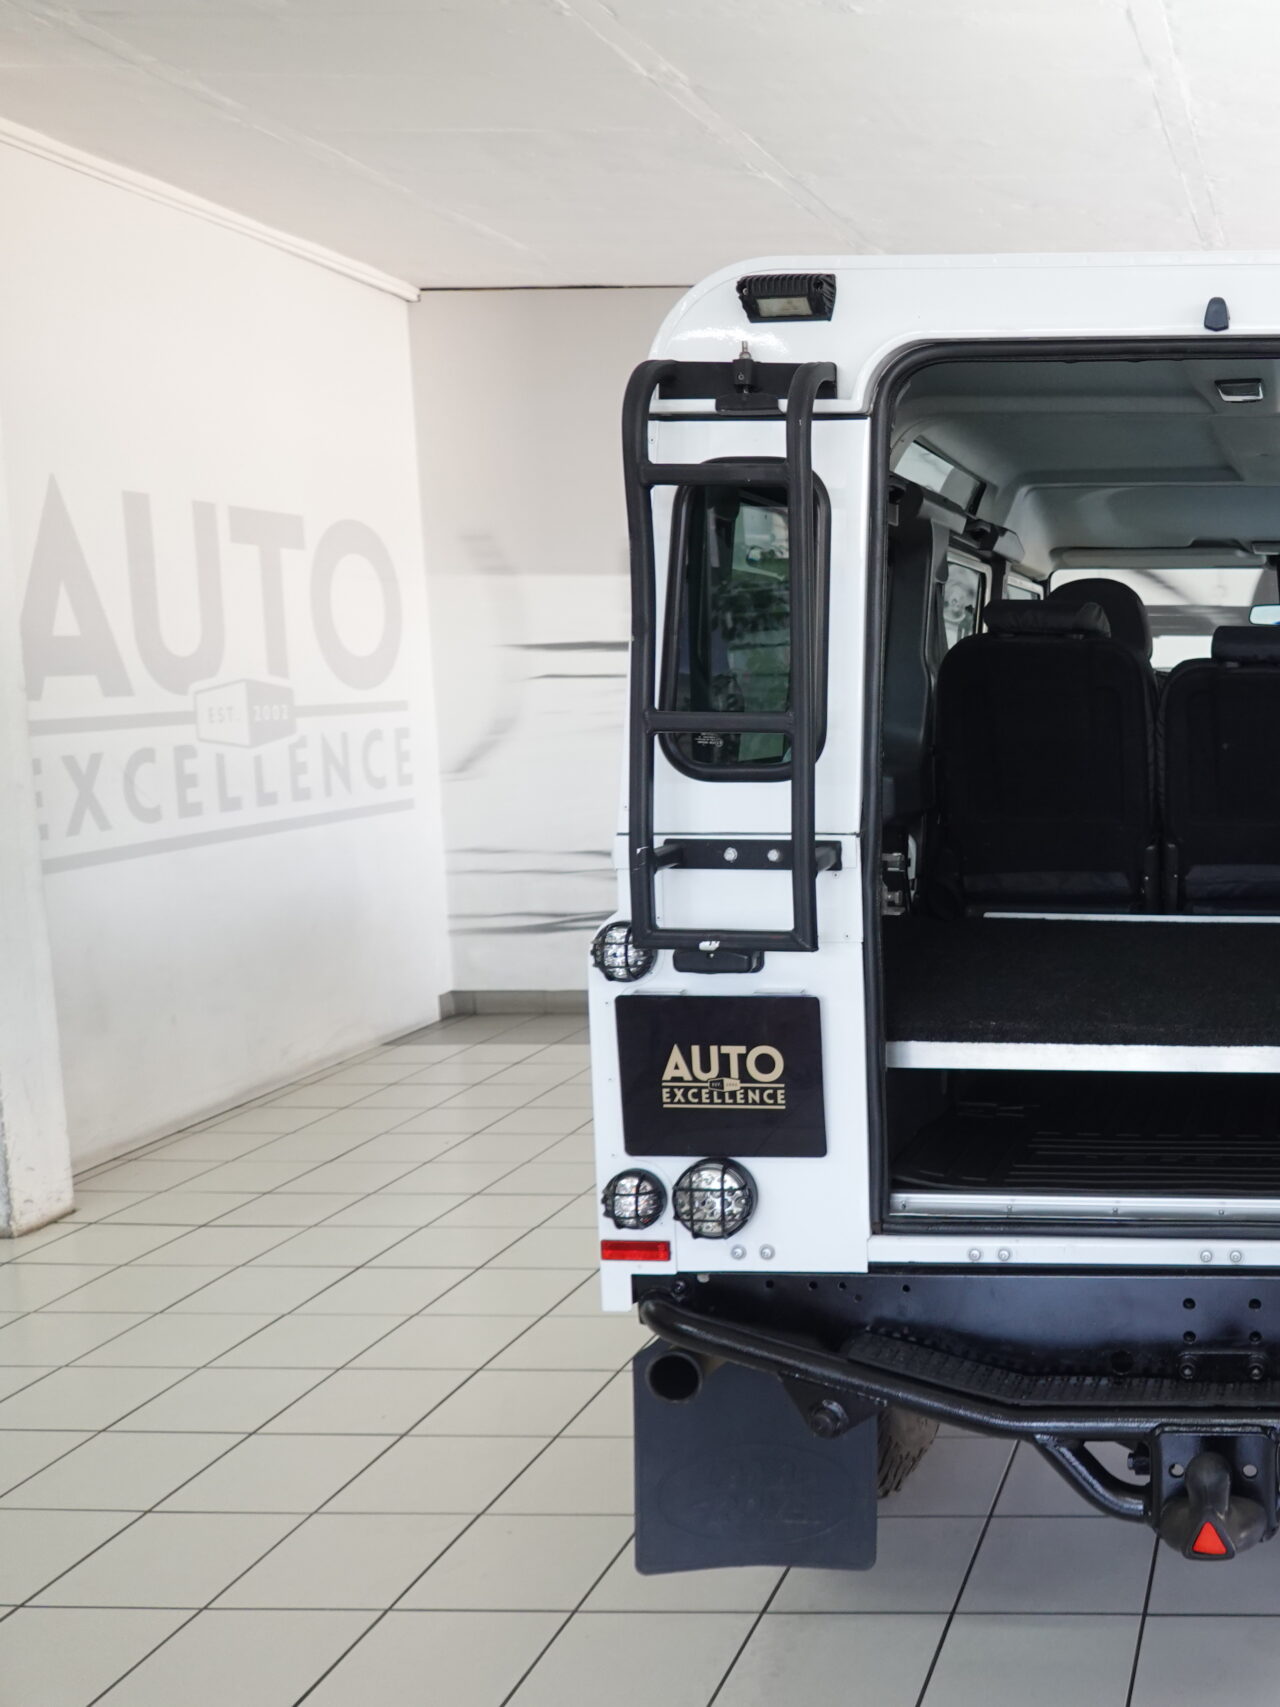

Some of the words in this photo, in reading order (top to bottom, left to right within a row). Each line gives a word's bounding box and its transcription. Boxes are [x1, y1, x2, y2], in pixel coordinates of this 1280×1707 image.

[20, 473, 402, 700] AUTO
[661, 1044, 785, 1083] AUTO
[661, 1087, 786, 1104] EXCELLENCE
